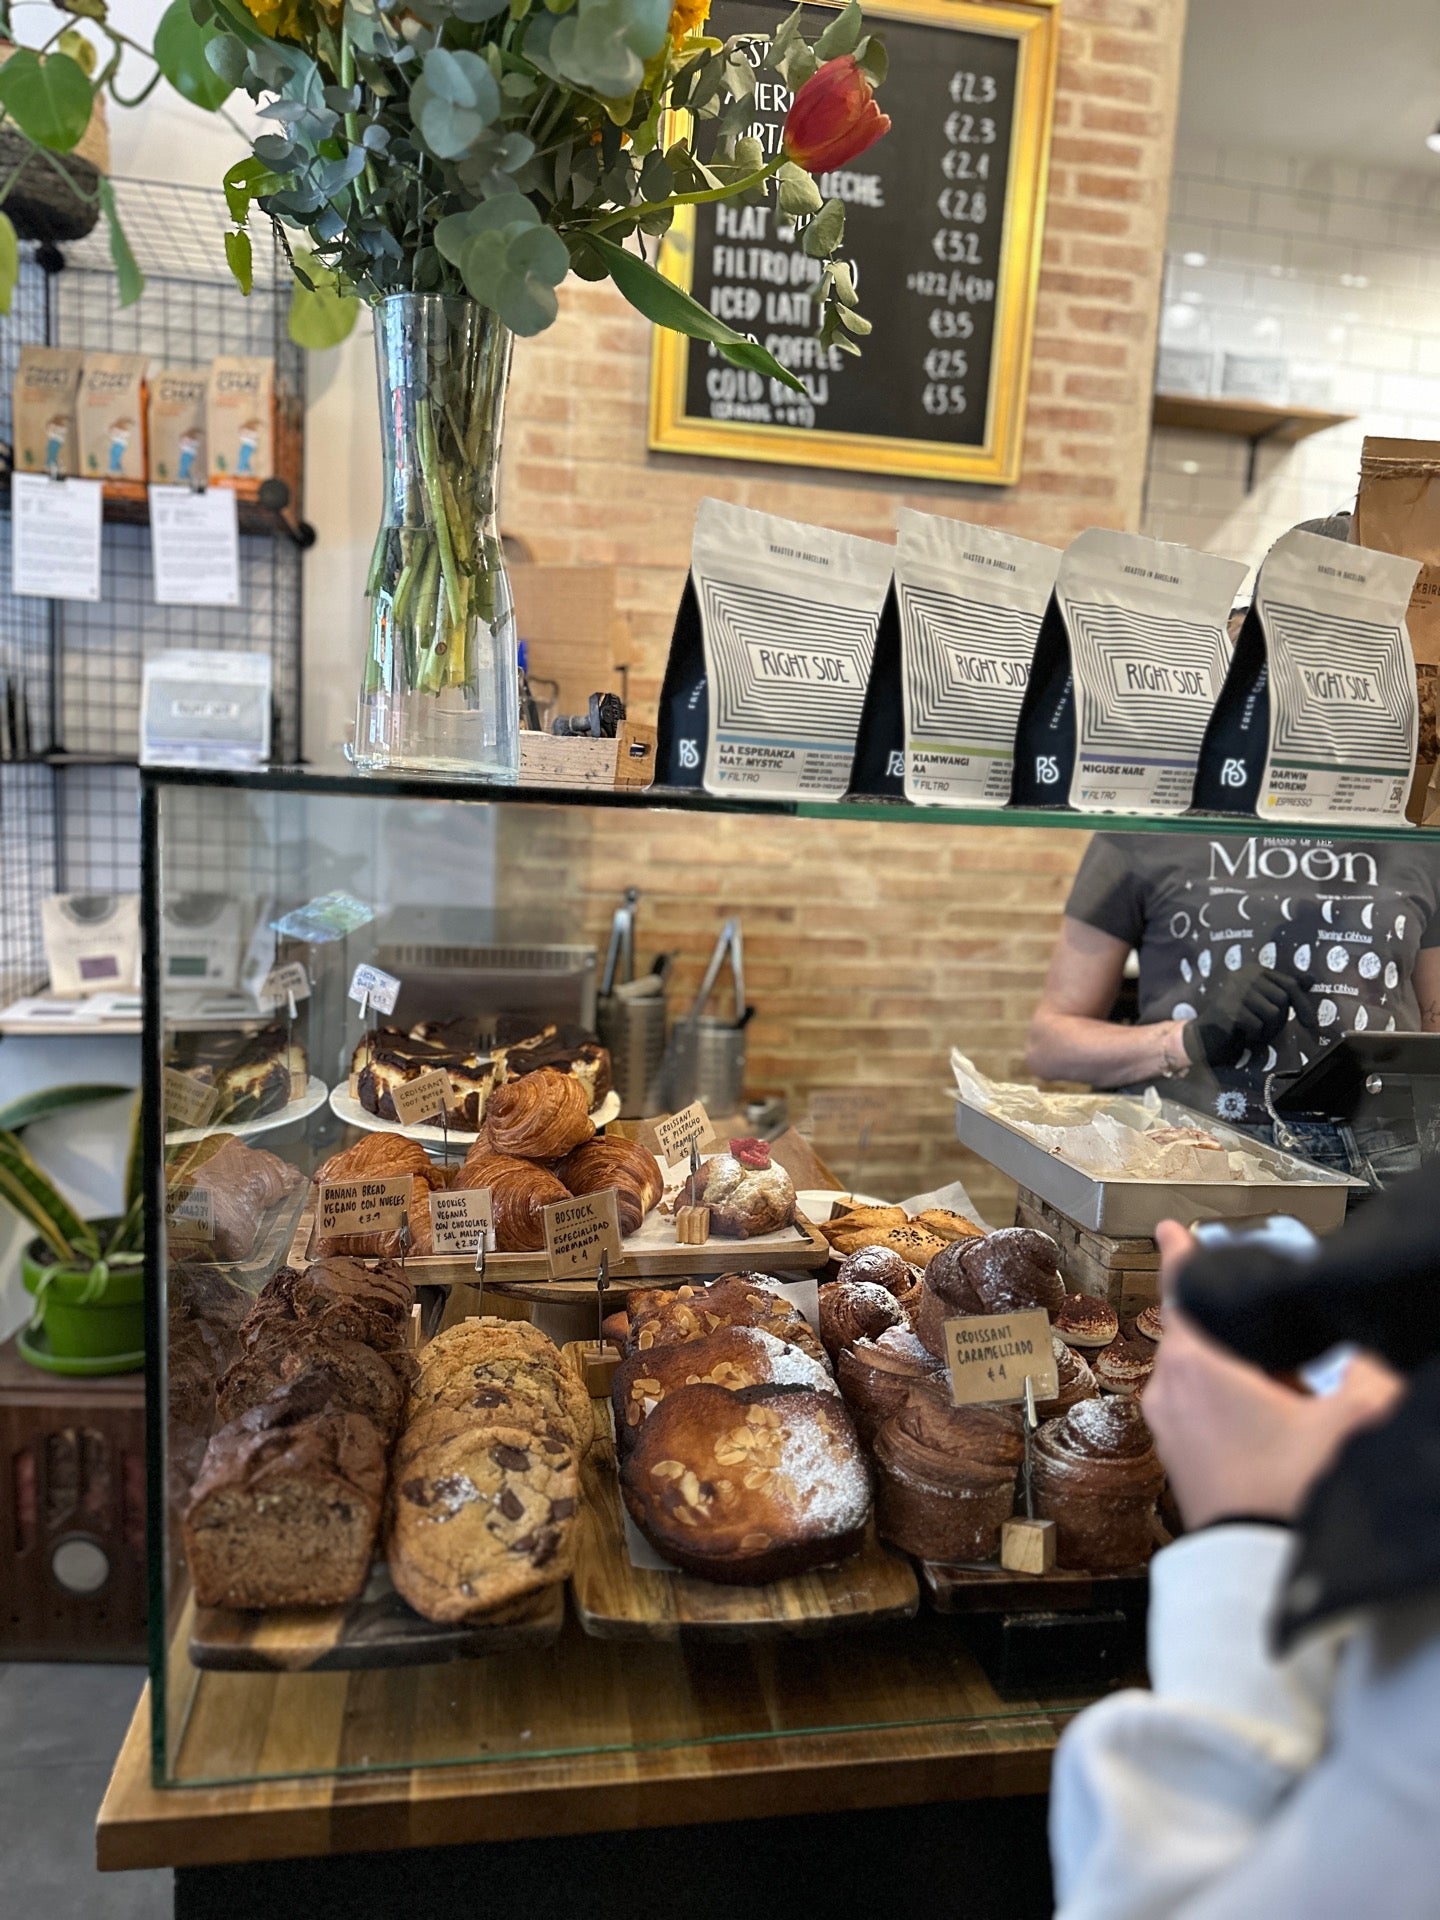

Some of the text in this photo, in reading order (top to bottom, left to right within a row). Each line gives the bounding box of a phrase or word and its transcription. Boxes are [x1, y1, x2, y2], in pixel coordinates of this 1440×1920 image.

[943, 110, 996, 144] €2.3
[820, 170, 886, 208] LECHE
[716, 203, 772, 241] FLAT
[711, 286, 761, 321] ICED
[706, 368, 764, 403] COLD
[759, 648, 851, 685] RIGHT SIDE
[954, 653, 1002, 684] RIGHT
[1125, 663, 1208, 697] RIGHT SIDE
[1303, 670, 1377, 704] RIGHT SIDE
[720, 744, 795, 759] LA ESPERANZA
[745, 758, 784, 769] MYSTIC
[912, 753, 970, 767] KIAMWANGI
[912, 764, 926, 774] AA
[1082, 763, 1146, 776] NIGUSE NARE
[1271, 770, 1309, 781] DARWIN
[727, 772, 760, 784] FILTRO
[920, 780, 950, 792] FILTRO
[1269, 780, 1307, 792] MORENO
[1088, 790, 1117, 800] FILTRO
[1275, 796, 1313, 808] ESPRESSO
[1207, 836, 1379, 886] Moon
[1344, 931, 1374, 944] Gibbous
[1310, 983, 1332, 994] axing
[400, 1078, 444, 1100] CROISSANT
[660, 1110, 691, 1136] CROISSANT
[662, 1117, 701, 1146] DE PISTACHO
[325, 1184, 387, 1200] BANANA BREAD
[324, 1201, 357, 1214] VEGANO
[360, 1197, 376, 1210] CON
[437, 1198, 466, 1208] COOKIES
[436, 1209, 468, 1220] VEGANAS
[555, 1203, 594, 1224] BOSTOCK
[323, 1215, 336, 1229] (V)
[435, 1219, 489, 1231] CON CHOCOLATE
[443, 1231, 457, 1240] SAL
[553, 1221, 610, 1245] ESPECIALIDAD
[555, 1234, 600, 1255] NORMANDA
[956, 1325, 1013, 1345] CROISSANT
[957, 1340, 1034, 1365] CARAMELIZADO
